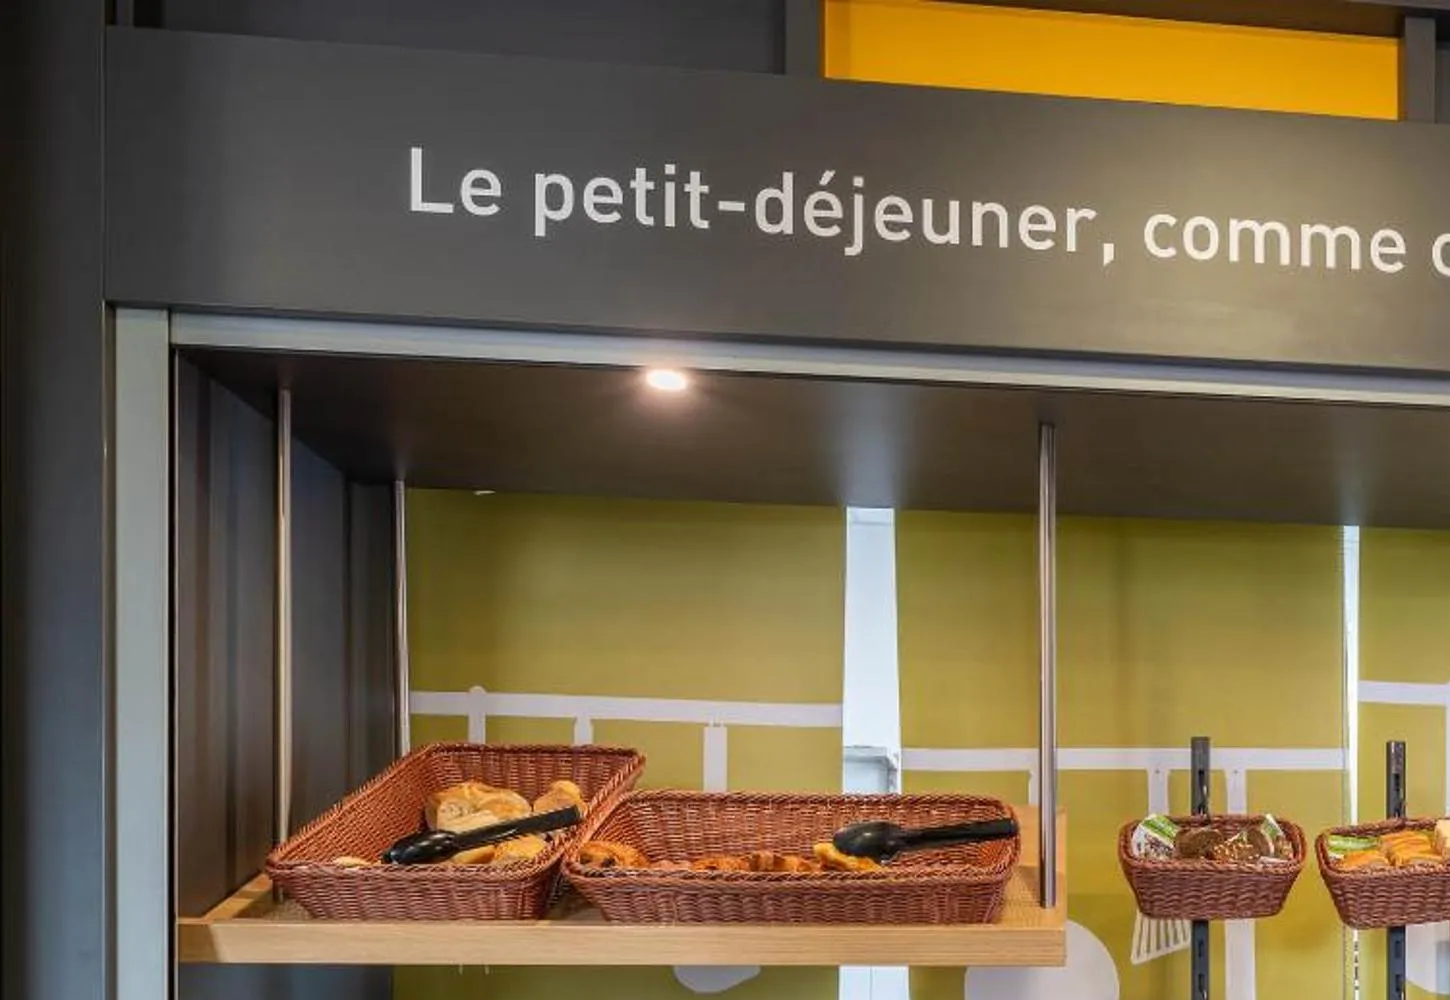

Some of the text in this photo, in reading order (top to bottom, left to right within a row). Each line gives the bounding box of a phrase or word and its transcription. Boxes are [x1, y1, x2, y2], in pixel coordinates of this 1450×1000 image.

[410, 146, 501, 216] Le
[534, 163, 1115, 266] petit-déjeuner,
[1143, 213, 1407, 274] comme
